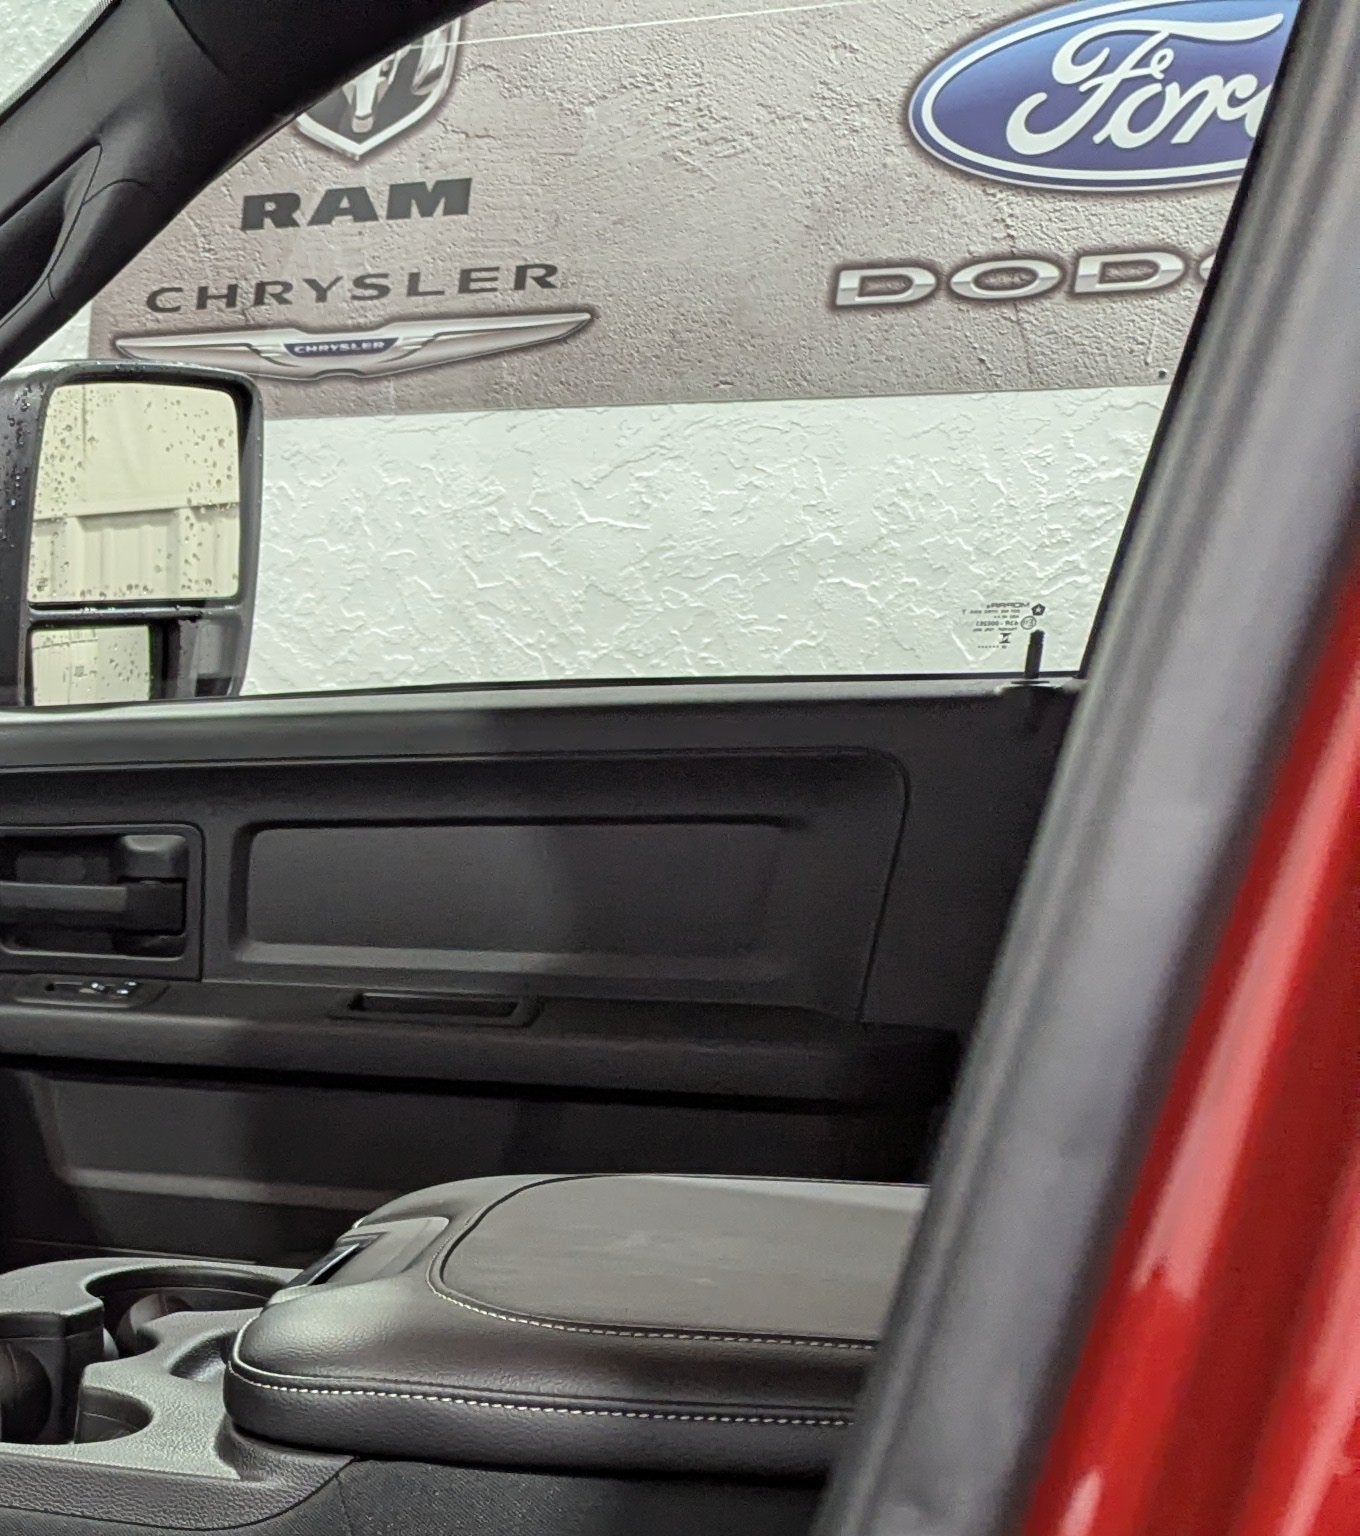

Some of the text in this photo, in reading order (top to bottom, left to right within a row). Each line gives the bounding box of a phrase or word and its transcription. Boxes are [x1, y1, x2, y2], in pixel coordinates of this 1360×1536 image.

[1006, 13, 1283, 155] For
[240, 177, 472, 231] RAM
[146, 263, 559, 314] CHRYSLER
[836, 250, 1216, 306] DOD
[294, 341, 385, 354] CHRYSLER
